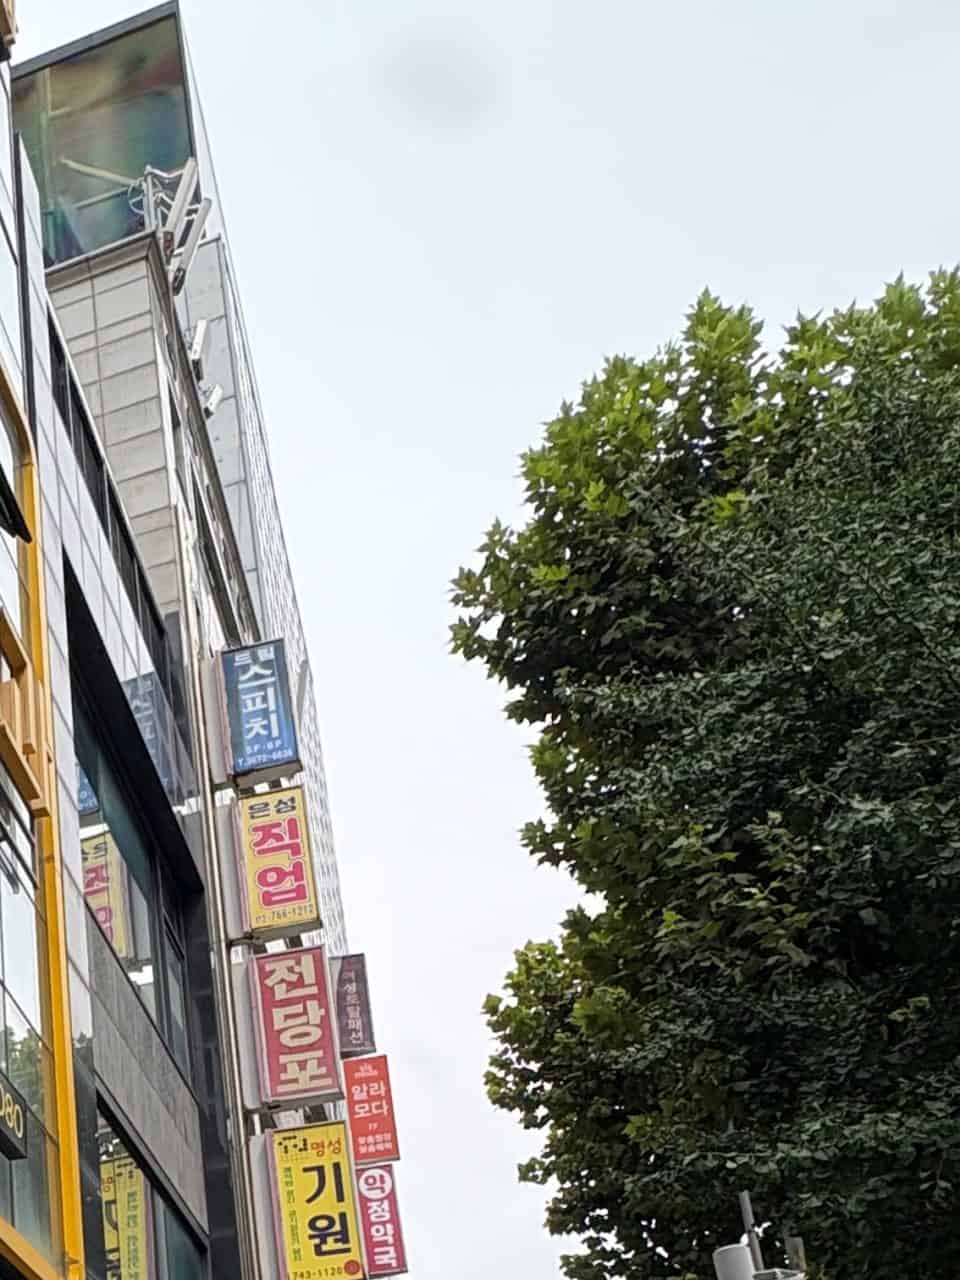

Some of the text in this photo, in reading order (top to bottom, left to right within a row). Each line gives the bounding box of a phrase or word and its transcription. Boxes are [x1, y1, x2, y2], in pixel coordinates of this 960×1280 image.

[237, 664, 280, 741] 스피치
[251, 816, 307, 907] 직업
[263, 954, 332, 1093] 전당포
[302, 1161, 352, 1257] 기원
